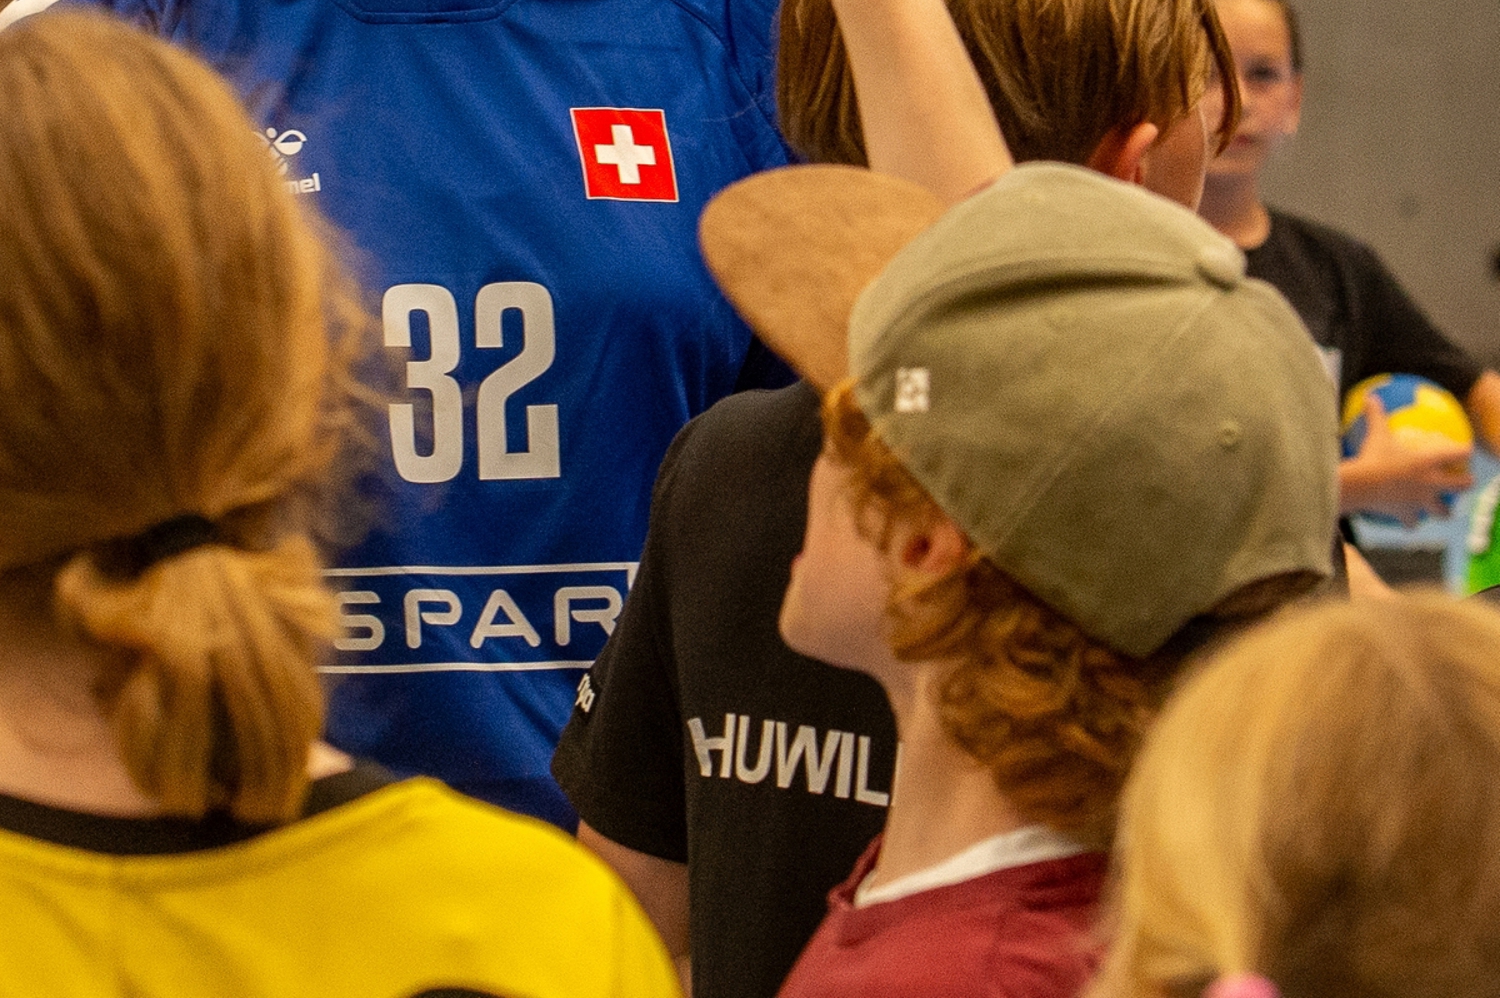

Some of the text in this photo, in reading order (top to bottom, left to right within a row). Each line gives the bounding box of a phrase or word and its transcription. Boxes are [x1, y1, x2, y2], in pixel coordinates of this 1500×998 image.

[382, 281, 561, 484] 32
[333, 585, 624, 652] SPAR
[687, 712, 890, 807] HUWIL
